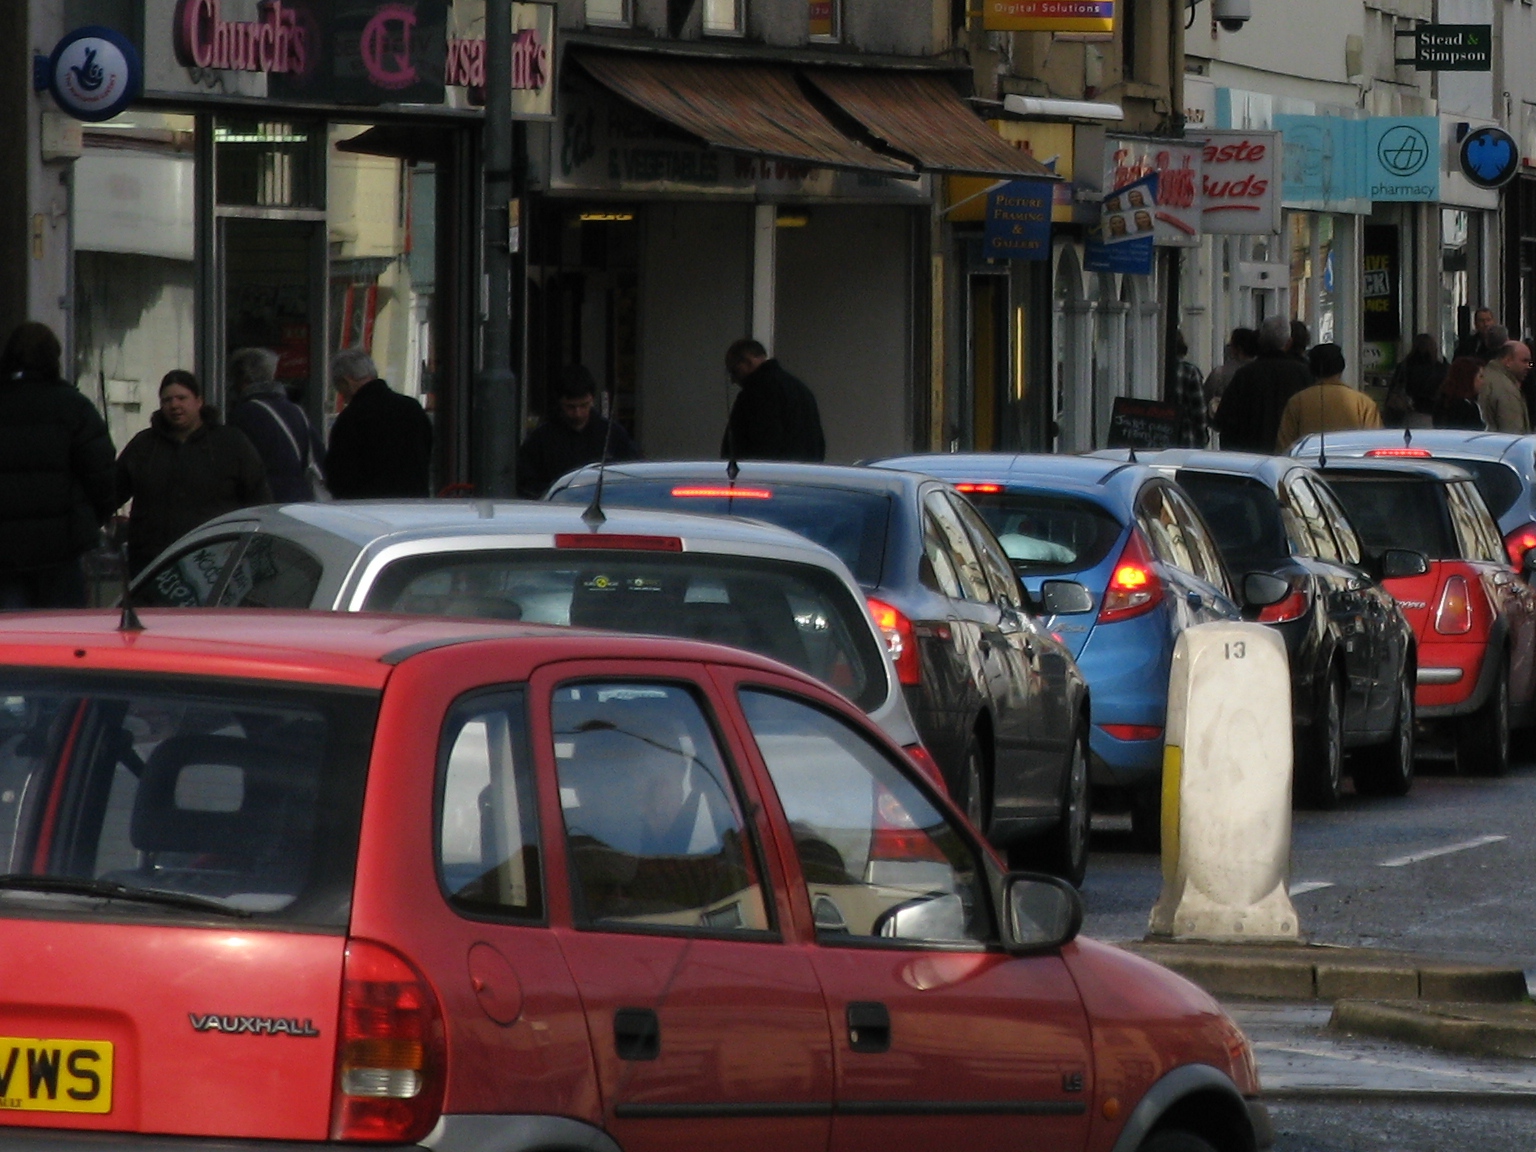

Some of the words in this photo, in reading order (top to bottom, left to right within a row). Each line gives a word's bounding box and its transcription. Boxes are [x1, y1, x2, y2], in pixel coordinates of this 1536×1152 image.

[994, 2, 1036, 14] Digital
[1042, 2, 1100, 13] Solutions
[1420, 33, 1463, 46] Stead
[1467, 34, 1480, 46] &
[1420, 49, 1486, 65] Simpson
[1203, 139, 1266, 163] aste
[1371, 183, 1435, 198] pharmacy
[995, 195, 1044, 209] PICTURE
[994, 209, 1044, 223] FRAMING
[1012, 224, 1023, 235] &
[991, 237, 1042, 250] GALLERY
[1224, 641, 1246, 660] 13
[188, 1013, 320, 1037] VAUXHALL
